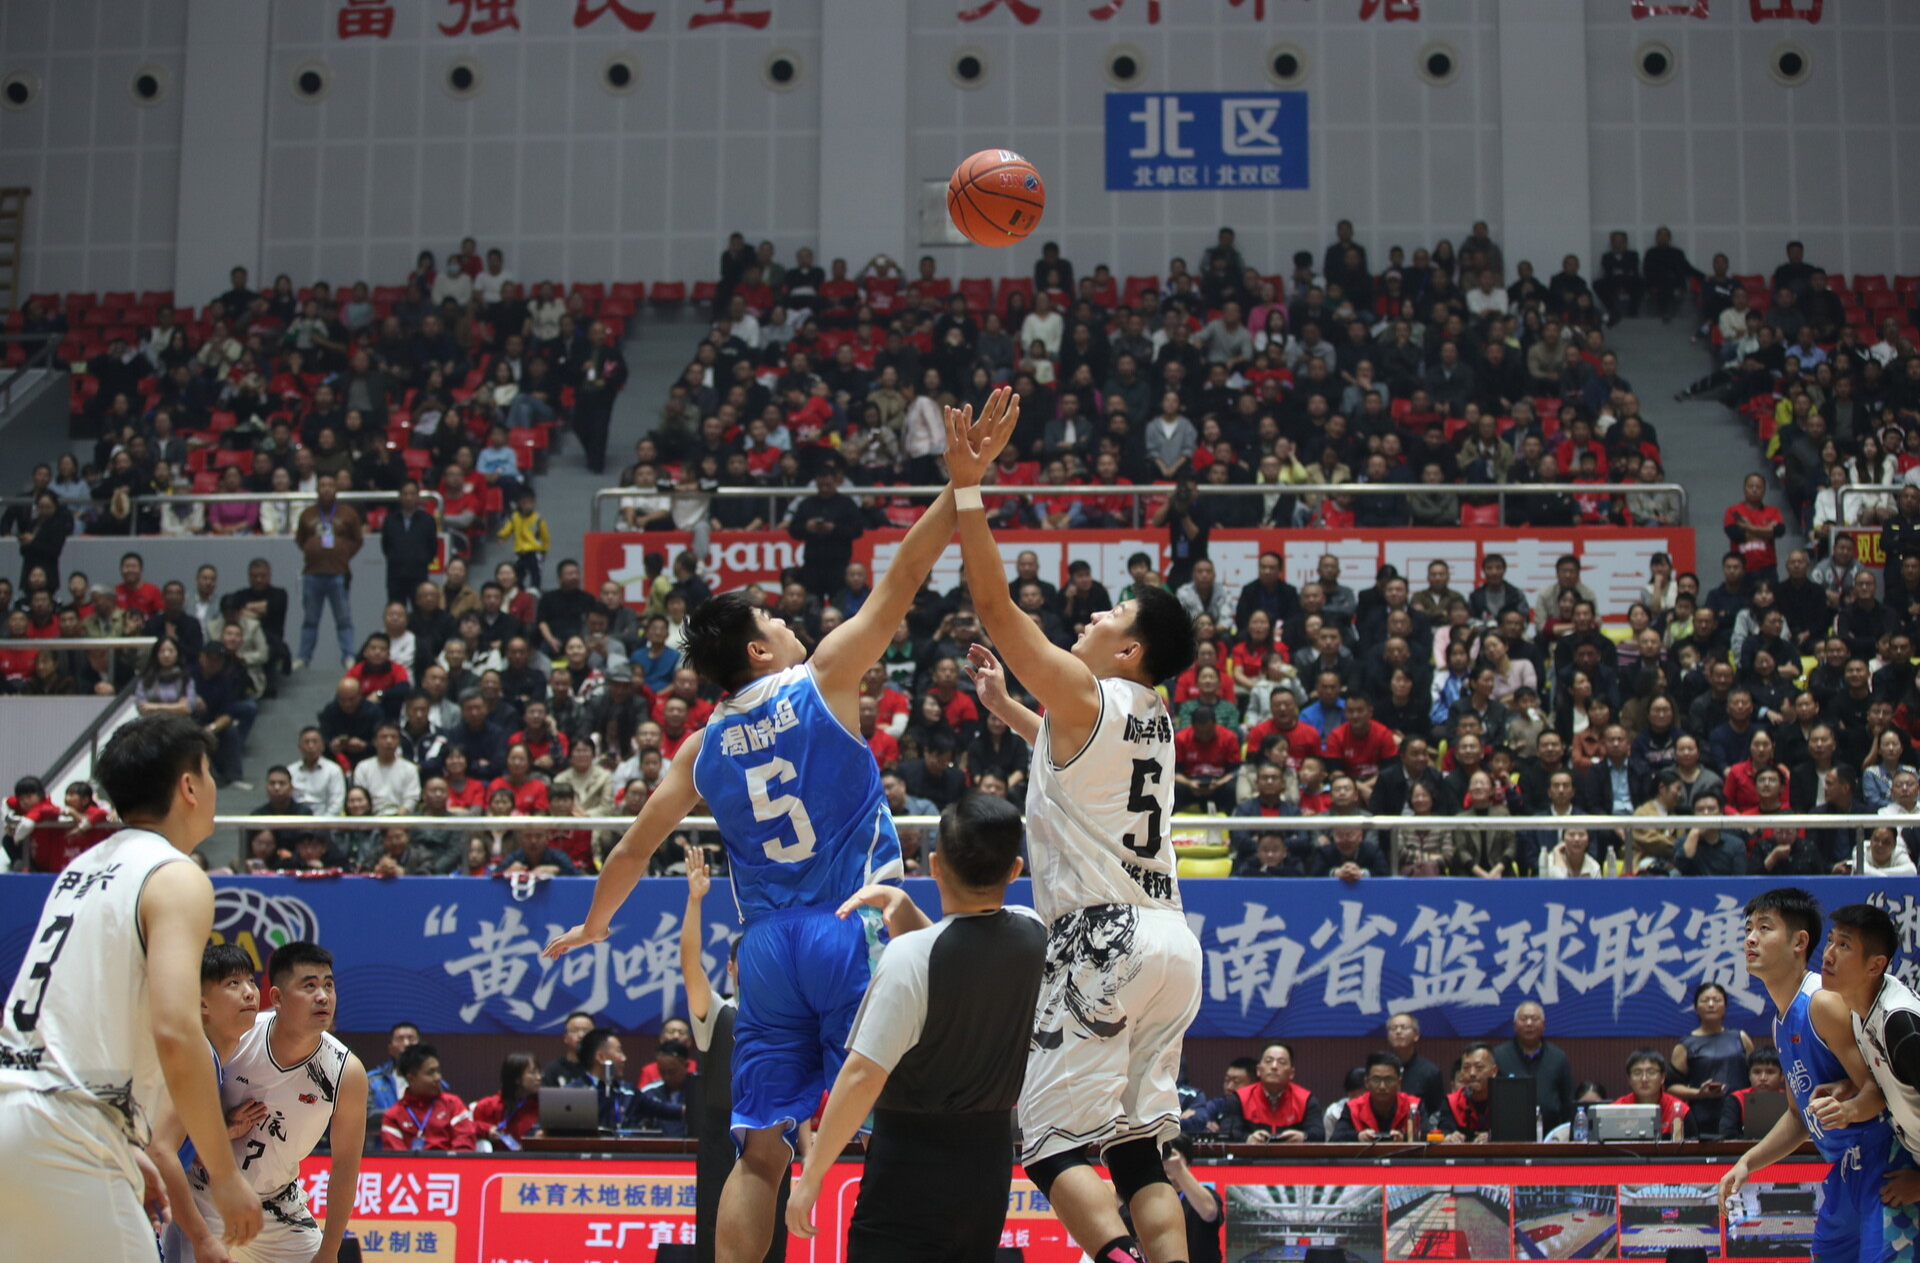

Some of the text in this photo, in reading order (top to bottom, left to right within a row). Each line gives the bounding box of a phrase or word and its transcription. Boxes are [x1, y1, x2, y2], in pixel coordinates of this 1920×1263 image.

[1129, 97, 1283, 158] 北区
[1133, 165, 1281, 186] 北单区 北双区
[745, 756, 817, 863] 5
[1122, 757, 1163, 859] 5
[13, 912, 74, 1032] 3
[1191, 895, 1766, 1021] 南省篮球联赛
[518, 1182, 697, 1208] 体育木地板制造
